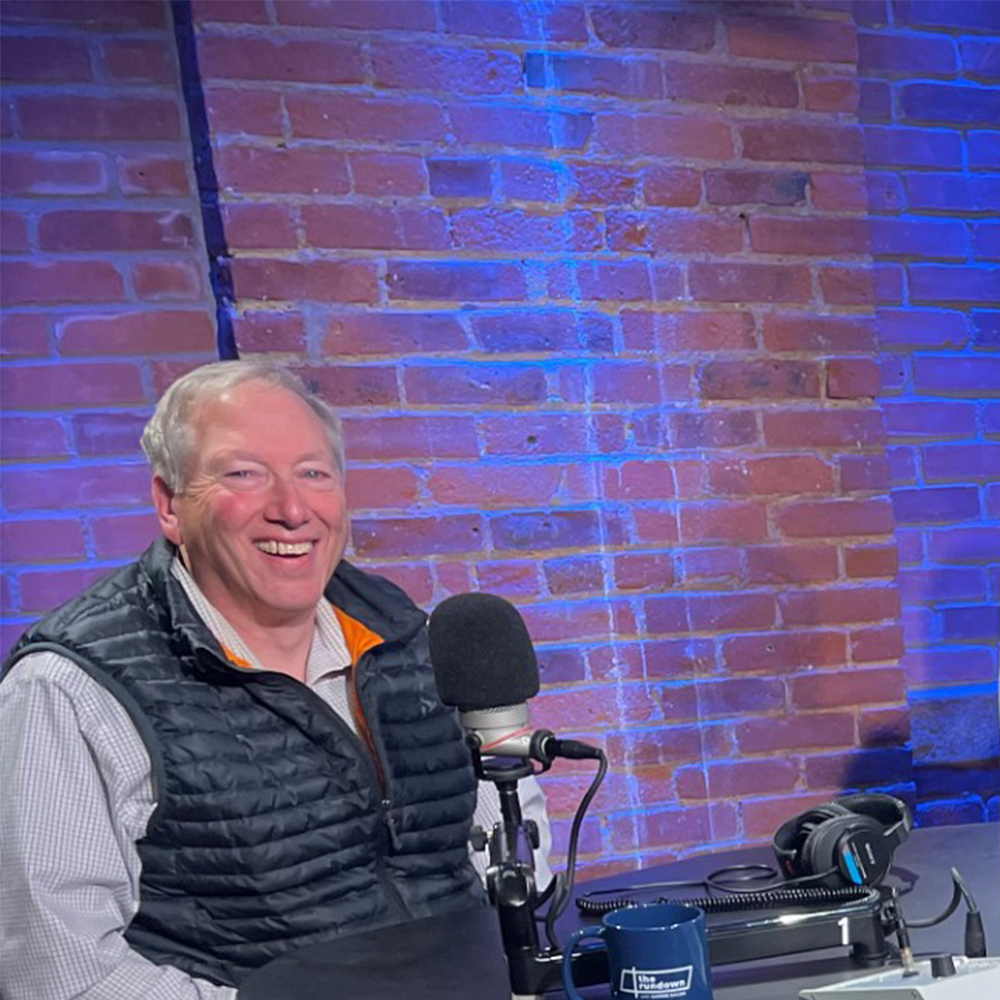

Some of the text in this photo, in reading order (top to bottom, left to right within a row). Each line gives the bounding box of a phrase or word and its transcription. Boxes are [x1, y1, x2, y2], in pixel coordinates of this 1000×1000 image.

[838, 916, 848, 945] 1
[638, 975, 656, 983] the
[639, 979, 686, 990] rundown
